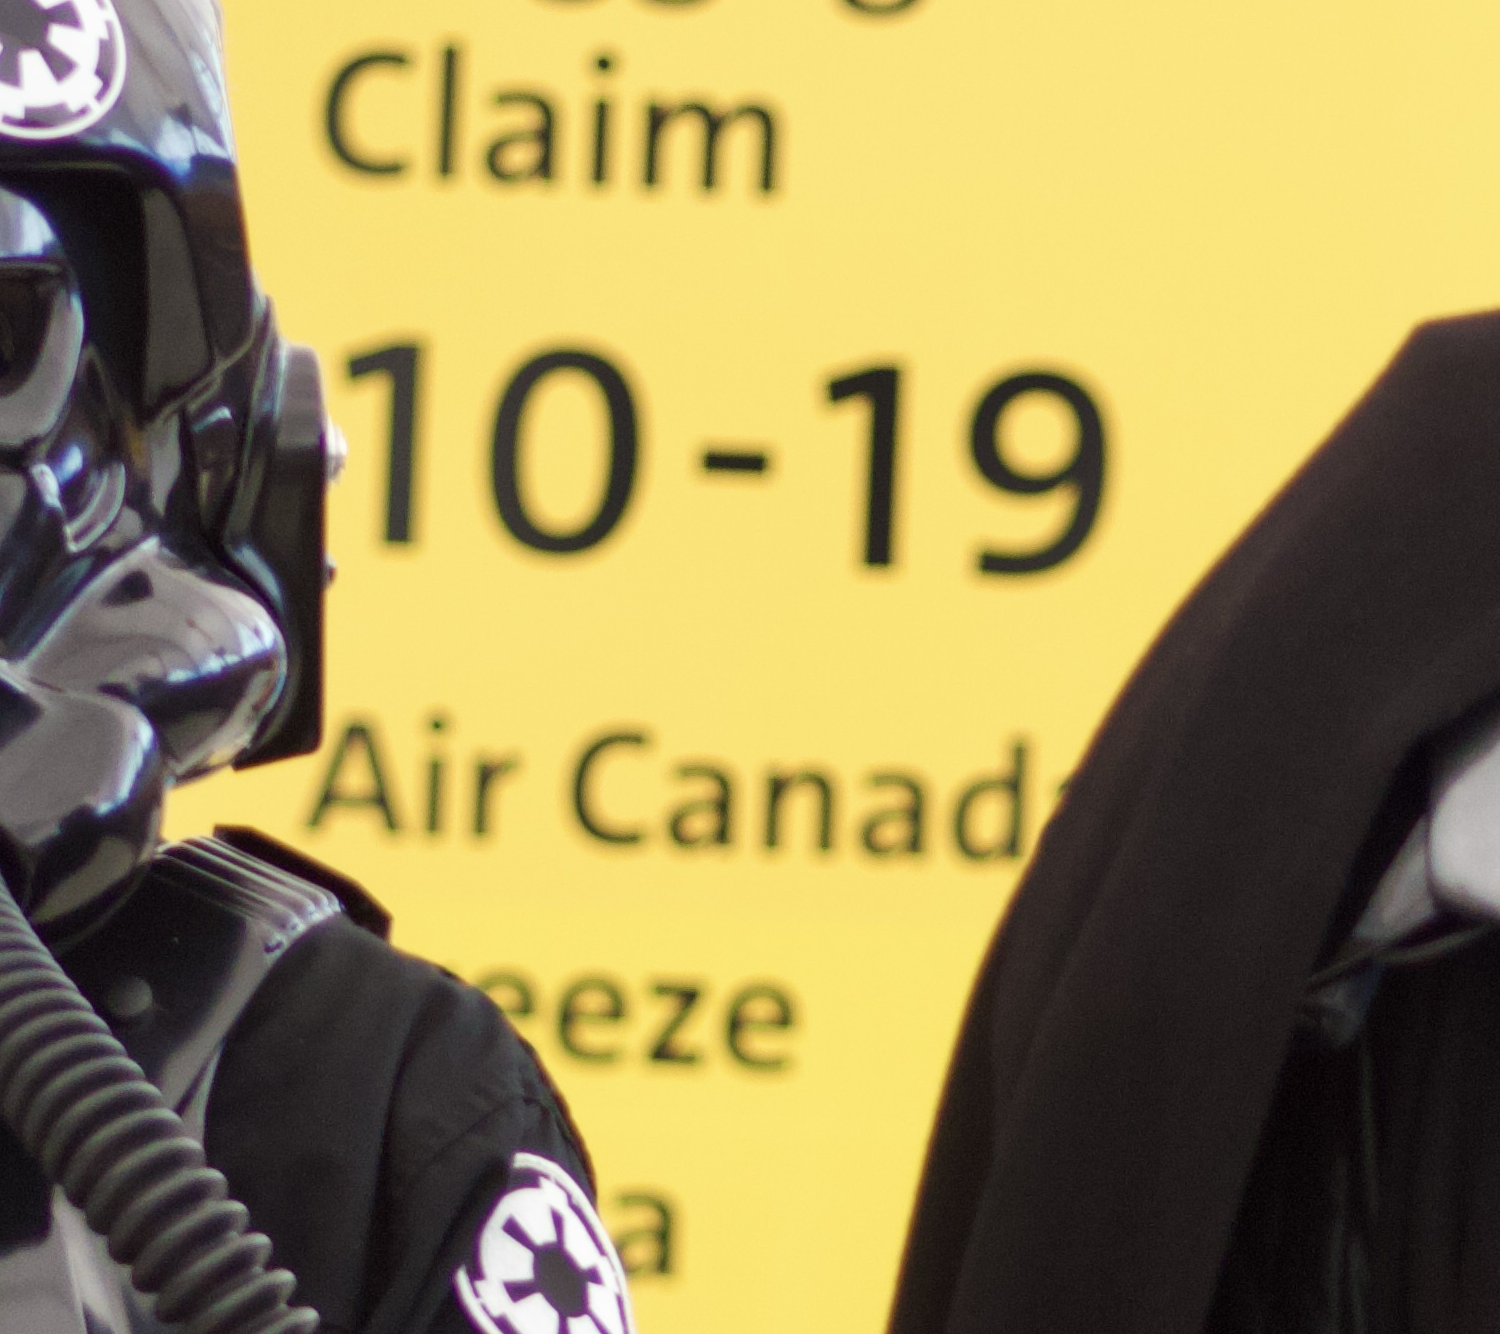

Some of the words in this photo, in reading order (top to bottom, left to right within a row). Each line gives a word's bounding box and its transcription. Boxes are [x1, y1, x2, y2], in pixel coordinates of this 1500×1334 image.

[320, 43, 782, 197] Claim
[305, 715, 517, 835] Air
[569, 727, 1068, 861] Canad
